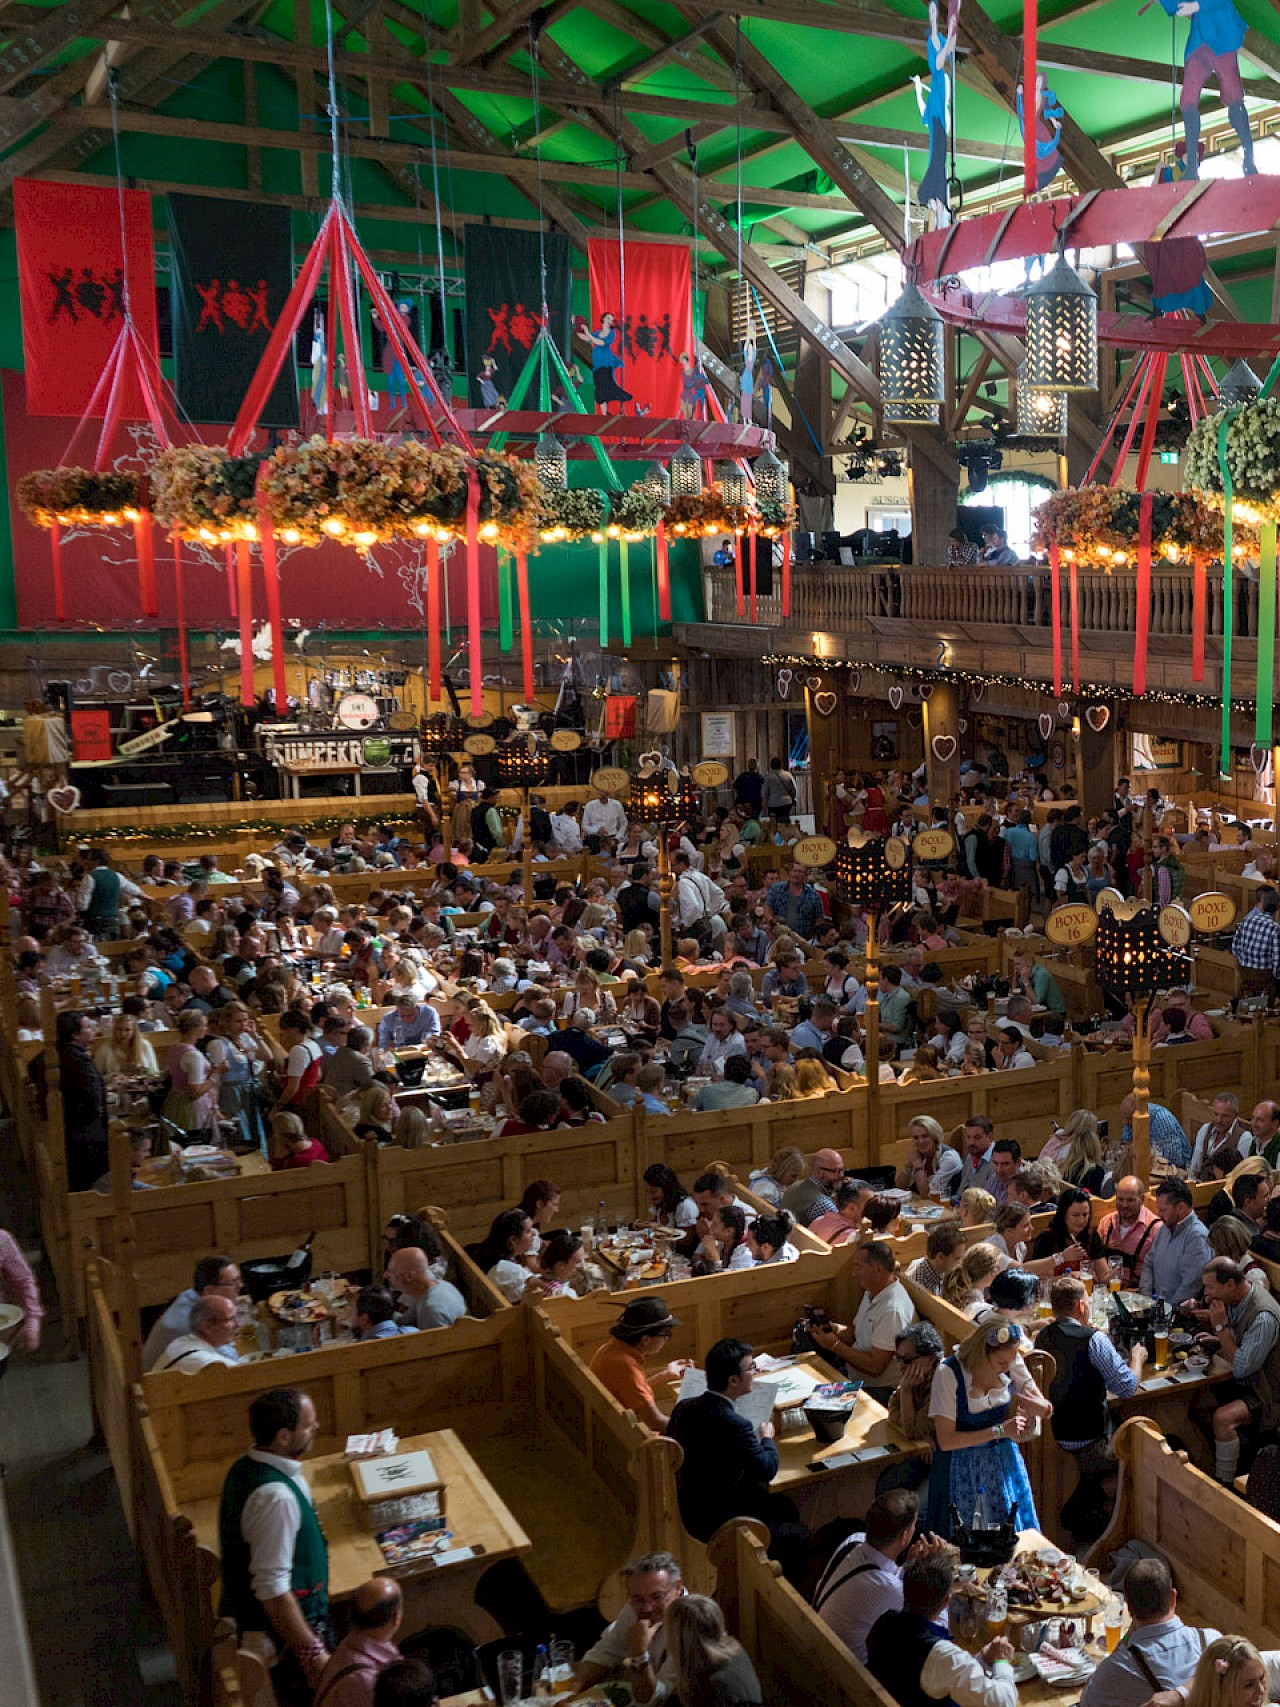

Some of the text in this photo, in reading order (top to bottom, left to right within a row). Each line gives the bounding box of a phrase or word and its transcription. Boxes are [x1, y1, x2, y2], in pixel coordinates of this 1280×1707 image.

[599, 773, 623, 781] BOXE
[698, 767, 722, 777] BOXE
[920, 836, 947, 846] BOXE
[802, 842, 829, 853] BOXE
[931, 846, 937, 855] 9
[811, 853, 819, 863] 9
[1196, 902, 1228, 915] BOXE
[1054, 911, 1090, 929] BOXE
[1163, 914, 1185, 931] BOXE
[1207, 915, 1219, 928] 10
[1067, 927, 1081, 941] 16
[1171, 929, 1180, 943] 16
